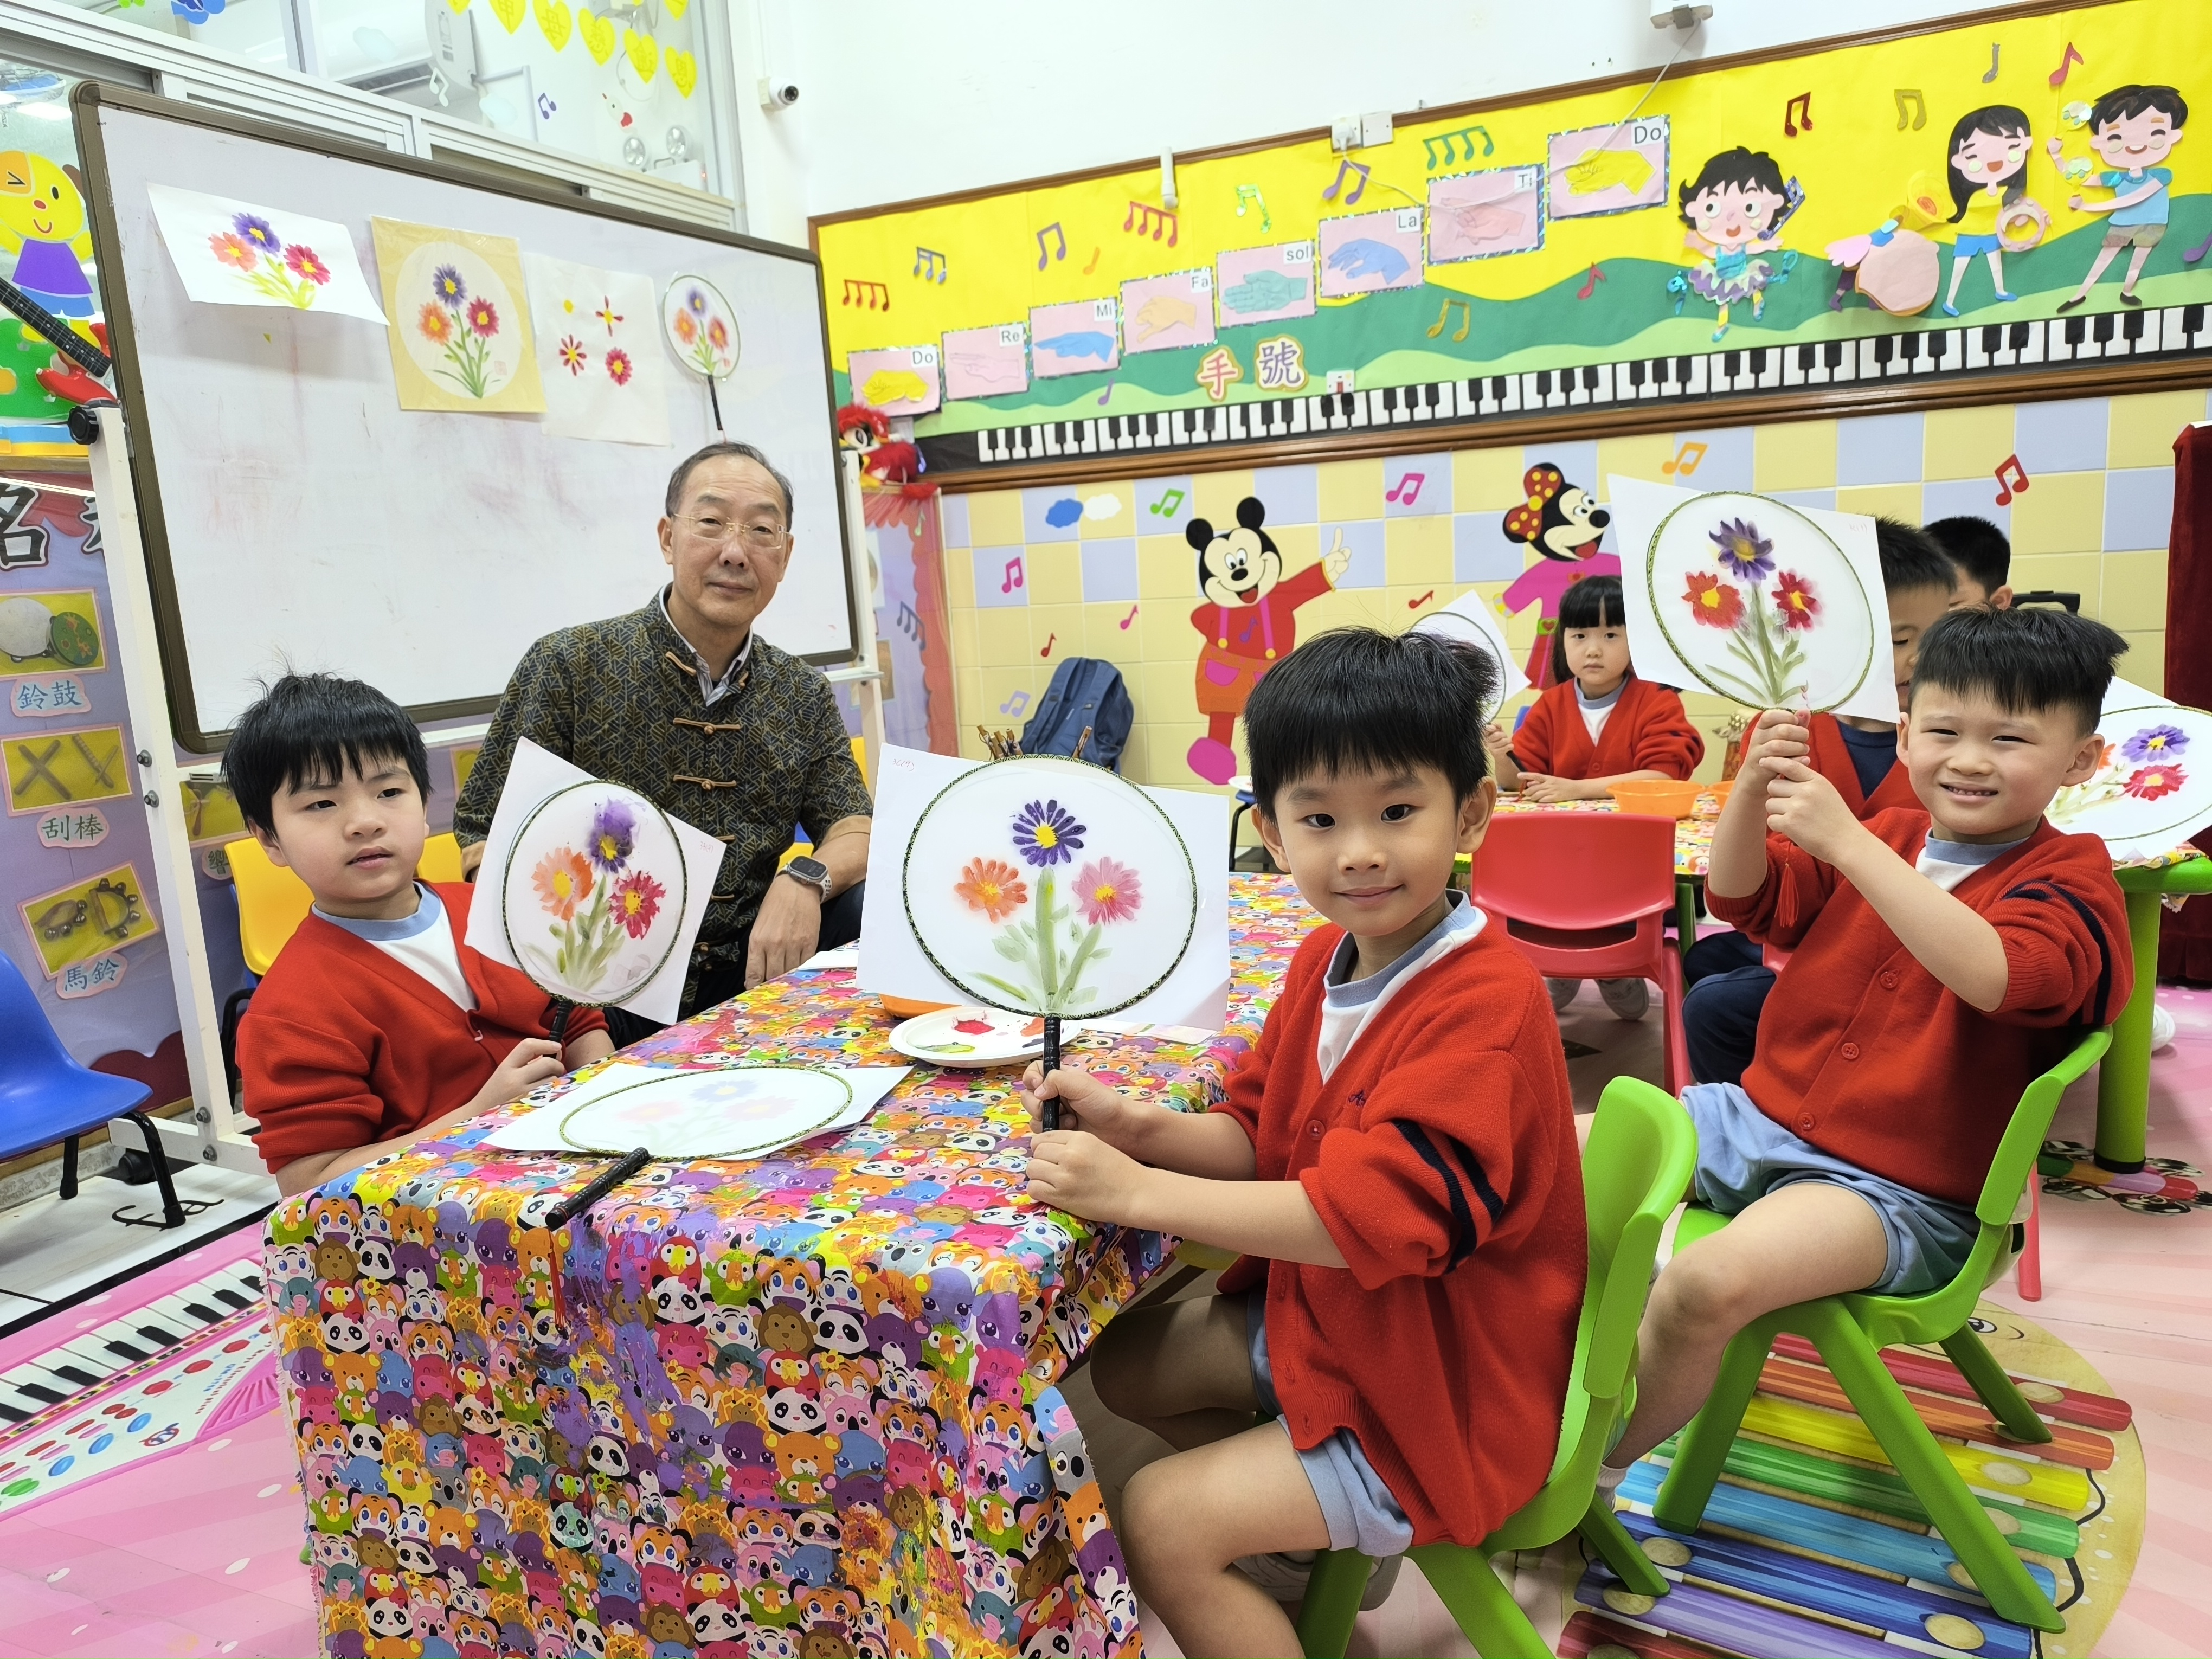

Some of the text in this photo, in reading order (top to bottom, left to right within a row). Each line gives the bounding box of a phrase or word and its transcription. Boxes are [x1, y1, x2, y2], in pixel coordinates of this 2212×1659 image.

[1634, 125, 1662, 144] Do
[1517, 169, 1533, 188] Ti
[1398, 214, 1417, 229] La
[1286, 246, 1309, 261] sol
[1191, 275, 1209, 288] Fa
[1096, 303, 1113, 318] Mi
[1001, 330, 1020, 343] Re
[912, 350, 933, 365] Do
[1200, 341, 1301, 397] 手號
[17, 680, 82, 709] 鈴鼓
[42, 813, 104, 841] 刮棒
[65, 958, 119, 991] 馬鈴
